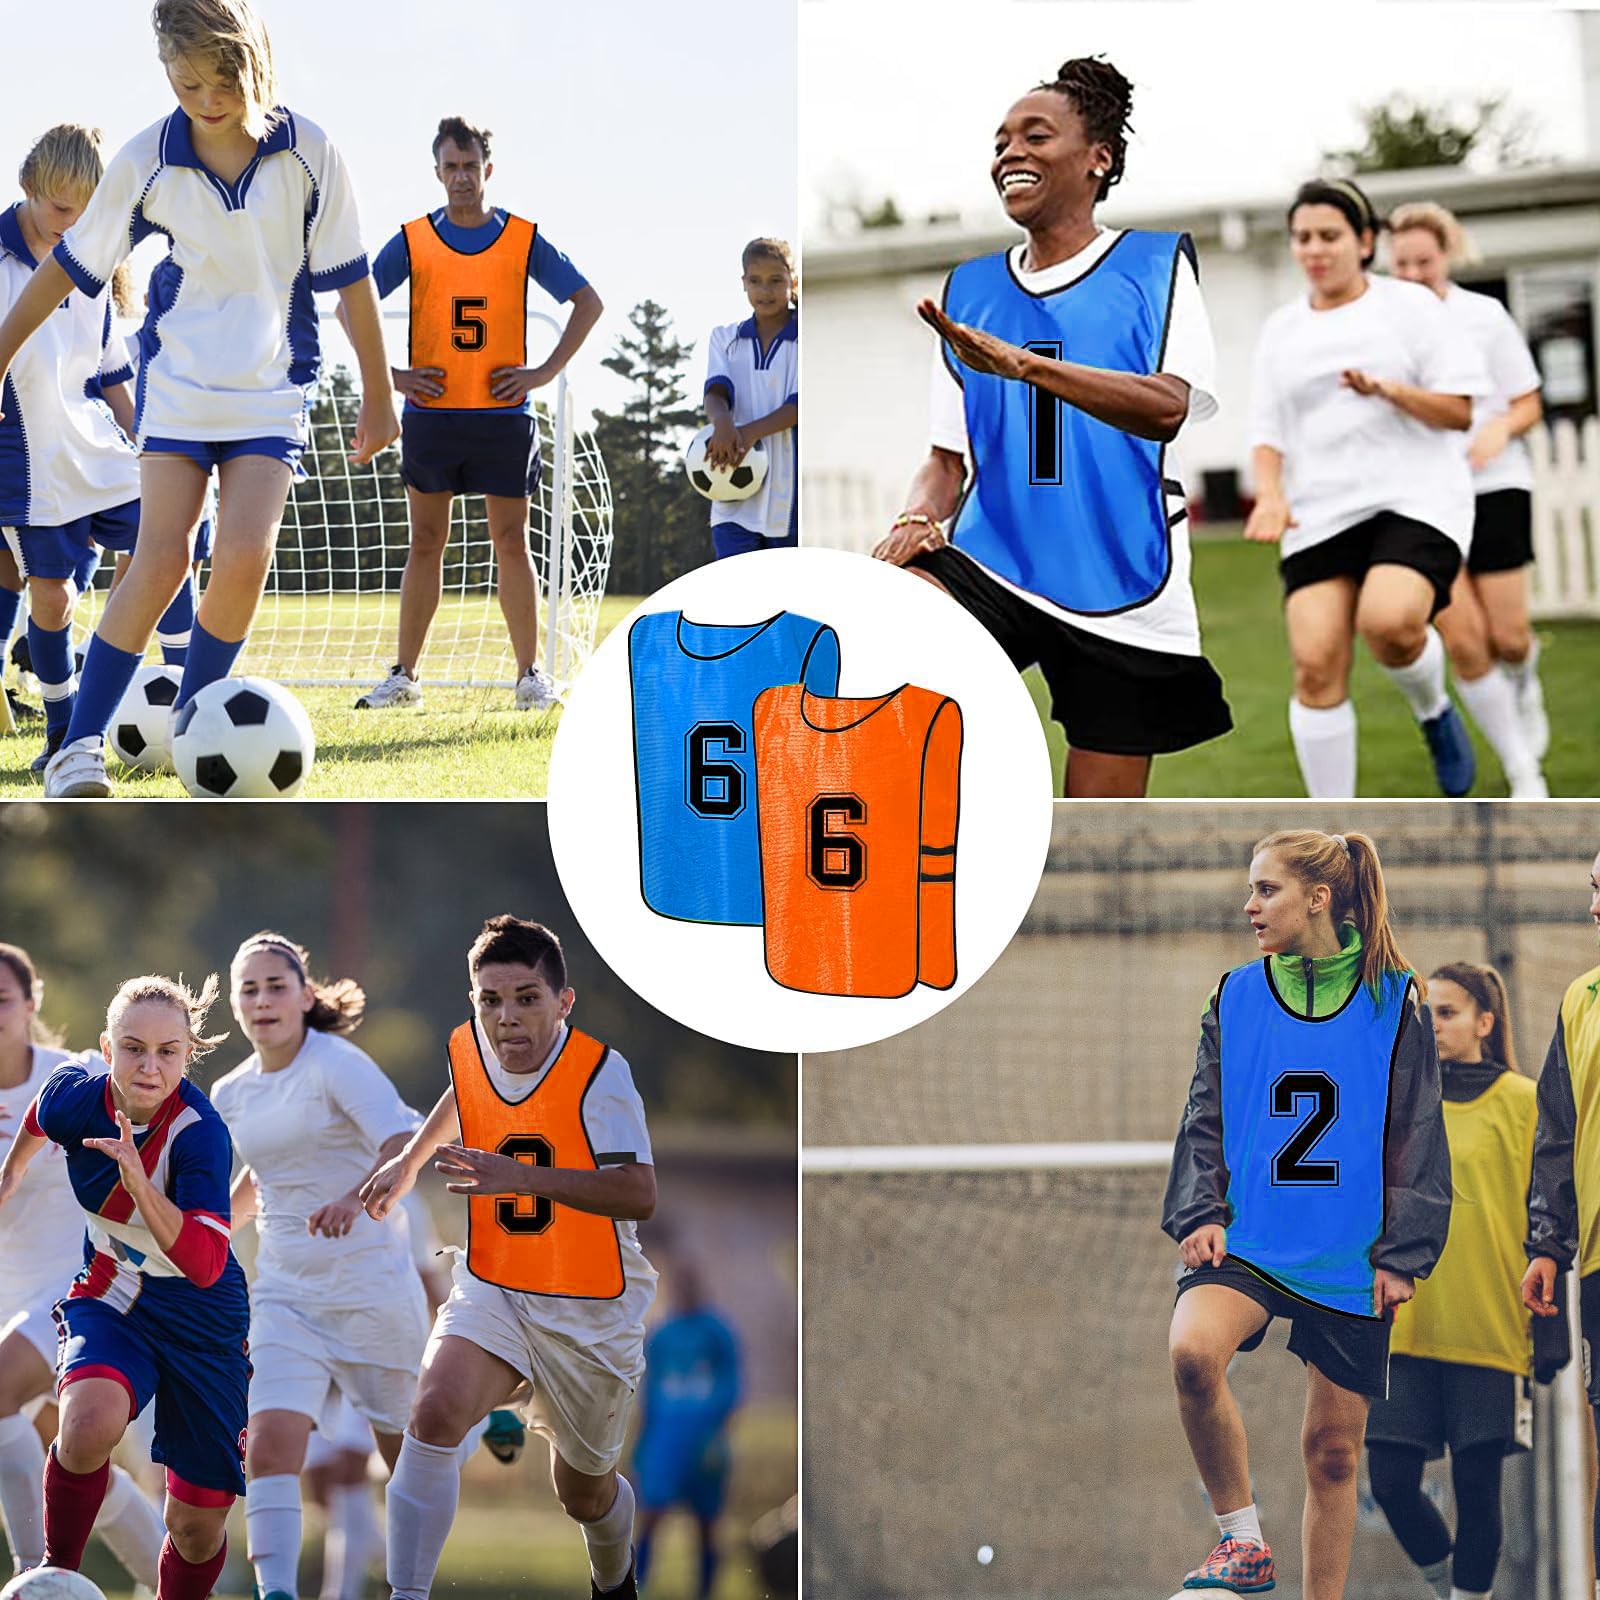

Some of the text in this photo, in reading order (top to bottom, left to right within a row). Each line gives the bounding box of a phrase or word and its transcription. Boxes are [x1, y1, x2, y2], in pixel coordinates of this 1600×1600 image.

[452, 296, 487, 352] 5
[1021, 341, 1062, 485] 1
[684, 720, 746, 820] 6
[805, 792, 867, 892] 6
[1269, 1070, 1340, 1187] 2
